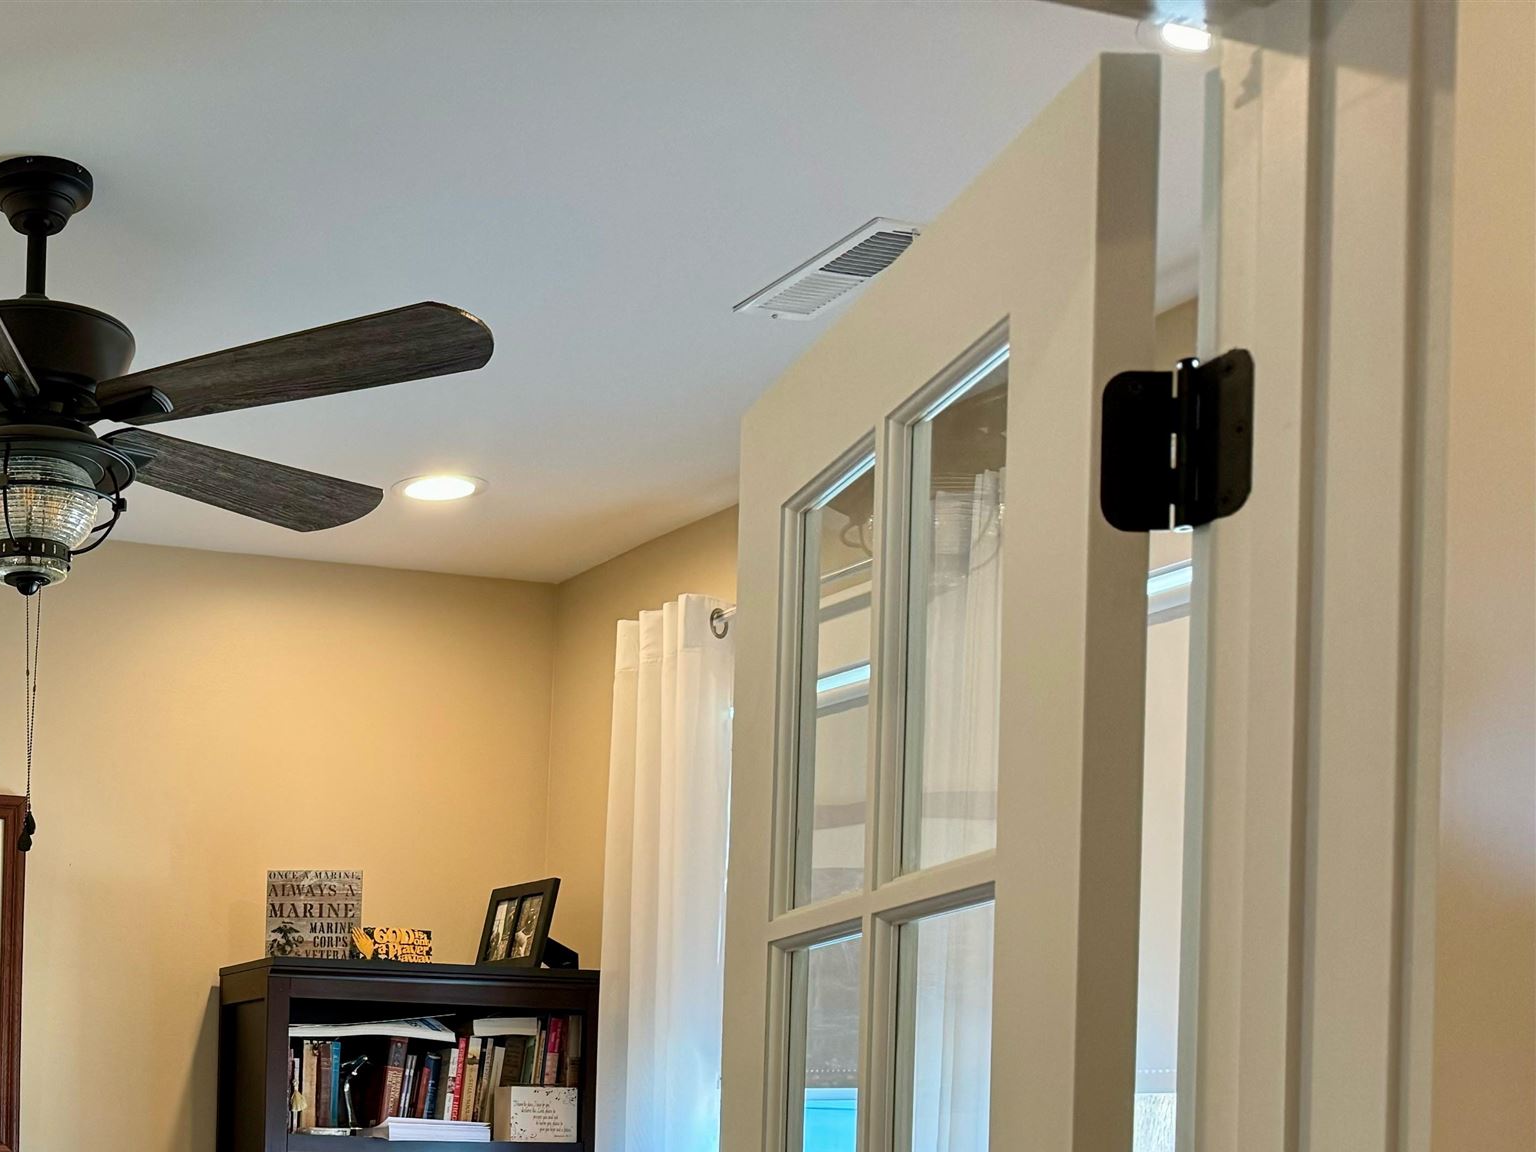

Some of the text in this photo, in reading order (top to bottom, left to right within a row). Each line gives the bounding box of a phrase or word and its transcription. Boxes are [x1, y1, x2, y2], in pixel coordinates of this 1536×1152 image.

[268, 871, 298, 881] ONCE
[302, 871, 311, 880] A
[268, 884, 357, 898] ALWAYS A
[268, 903, 356, 919] MARINE
[309, 922, 354, 934] MARINE
[313, 935, 349, 948] CORPS
[374, 926, 415, 945] GOD
[304, 949, 348, 960] VETERA
